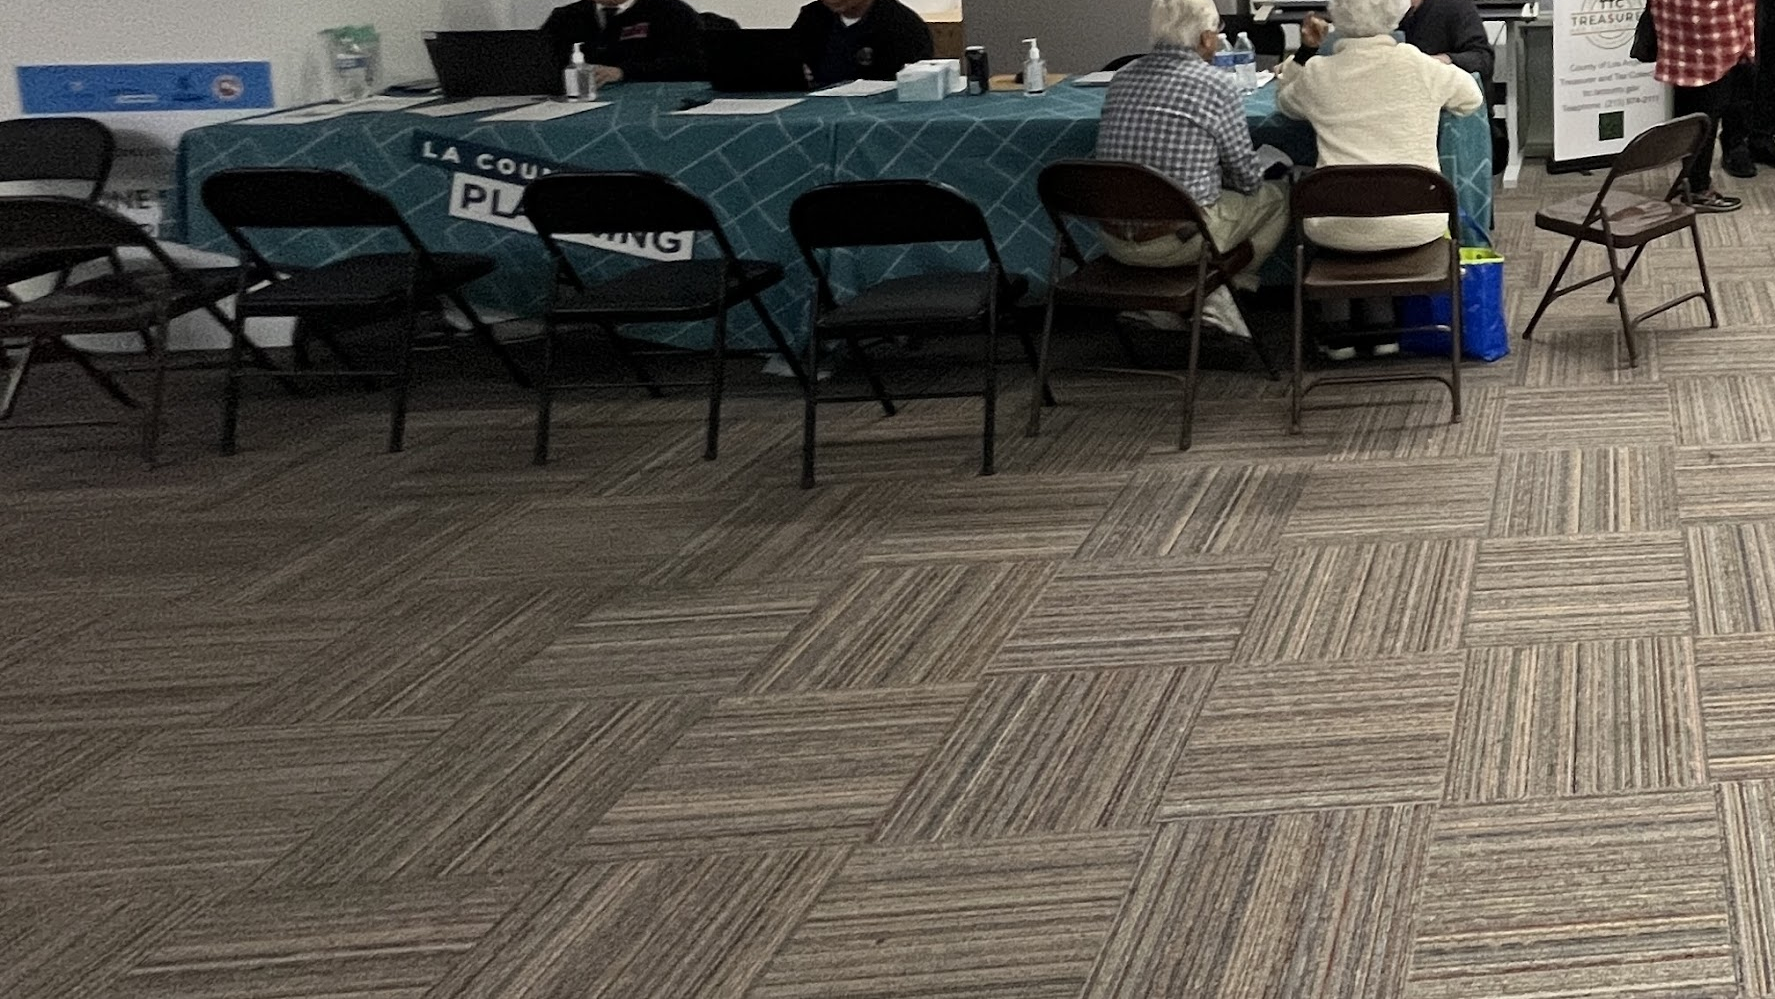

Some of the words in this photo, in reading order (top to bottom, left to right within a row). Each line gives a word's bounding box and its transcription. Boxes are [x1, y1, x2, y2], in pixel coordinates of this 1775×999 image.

[1571, 12, 1642, 27] TREASURE
[422, 140, 461, 164] LA
[476, 152, 552, 180] COU
